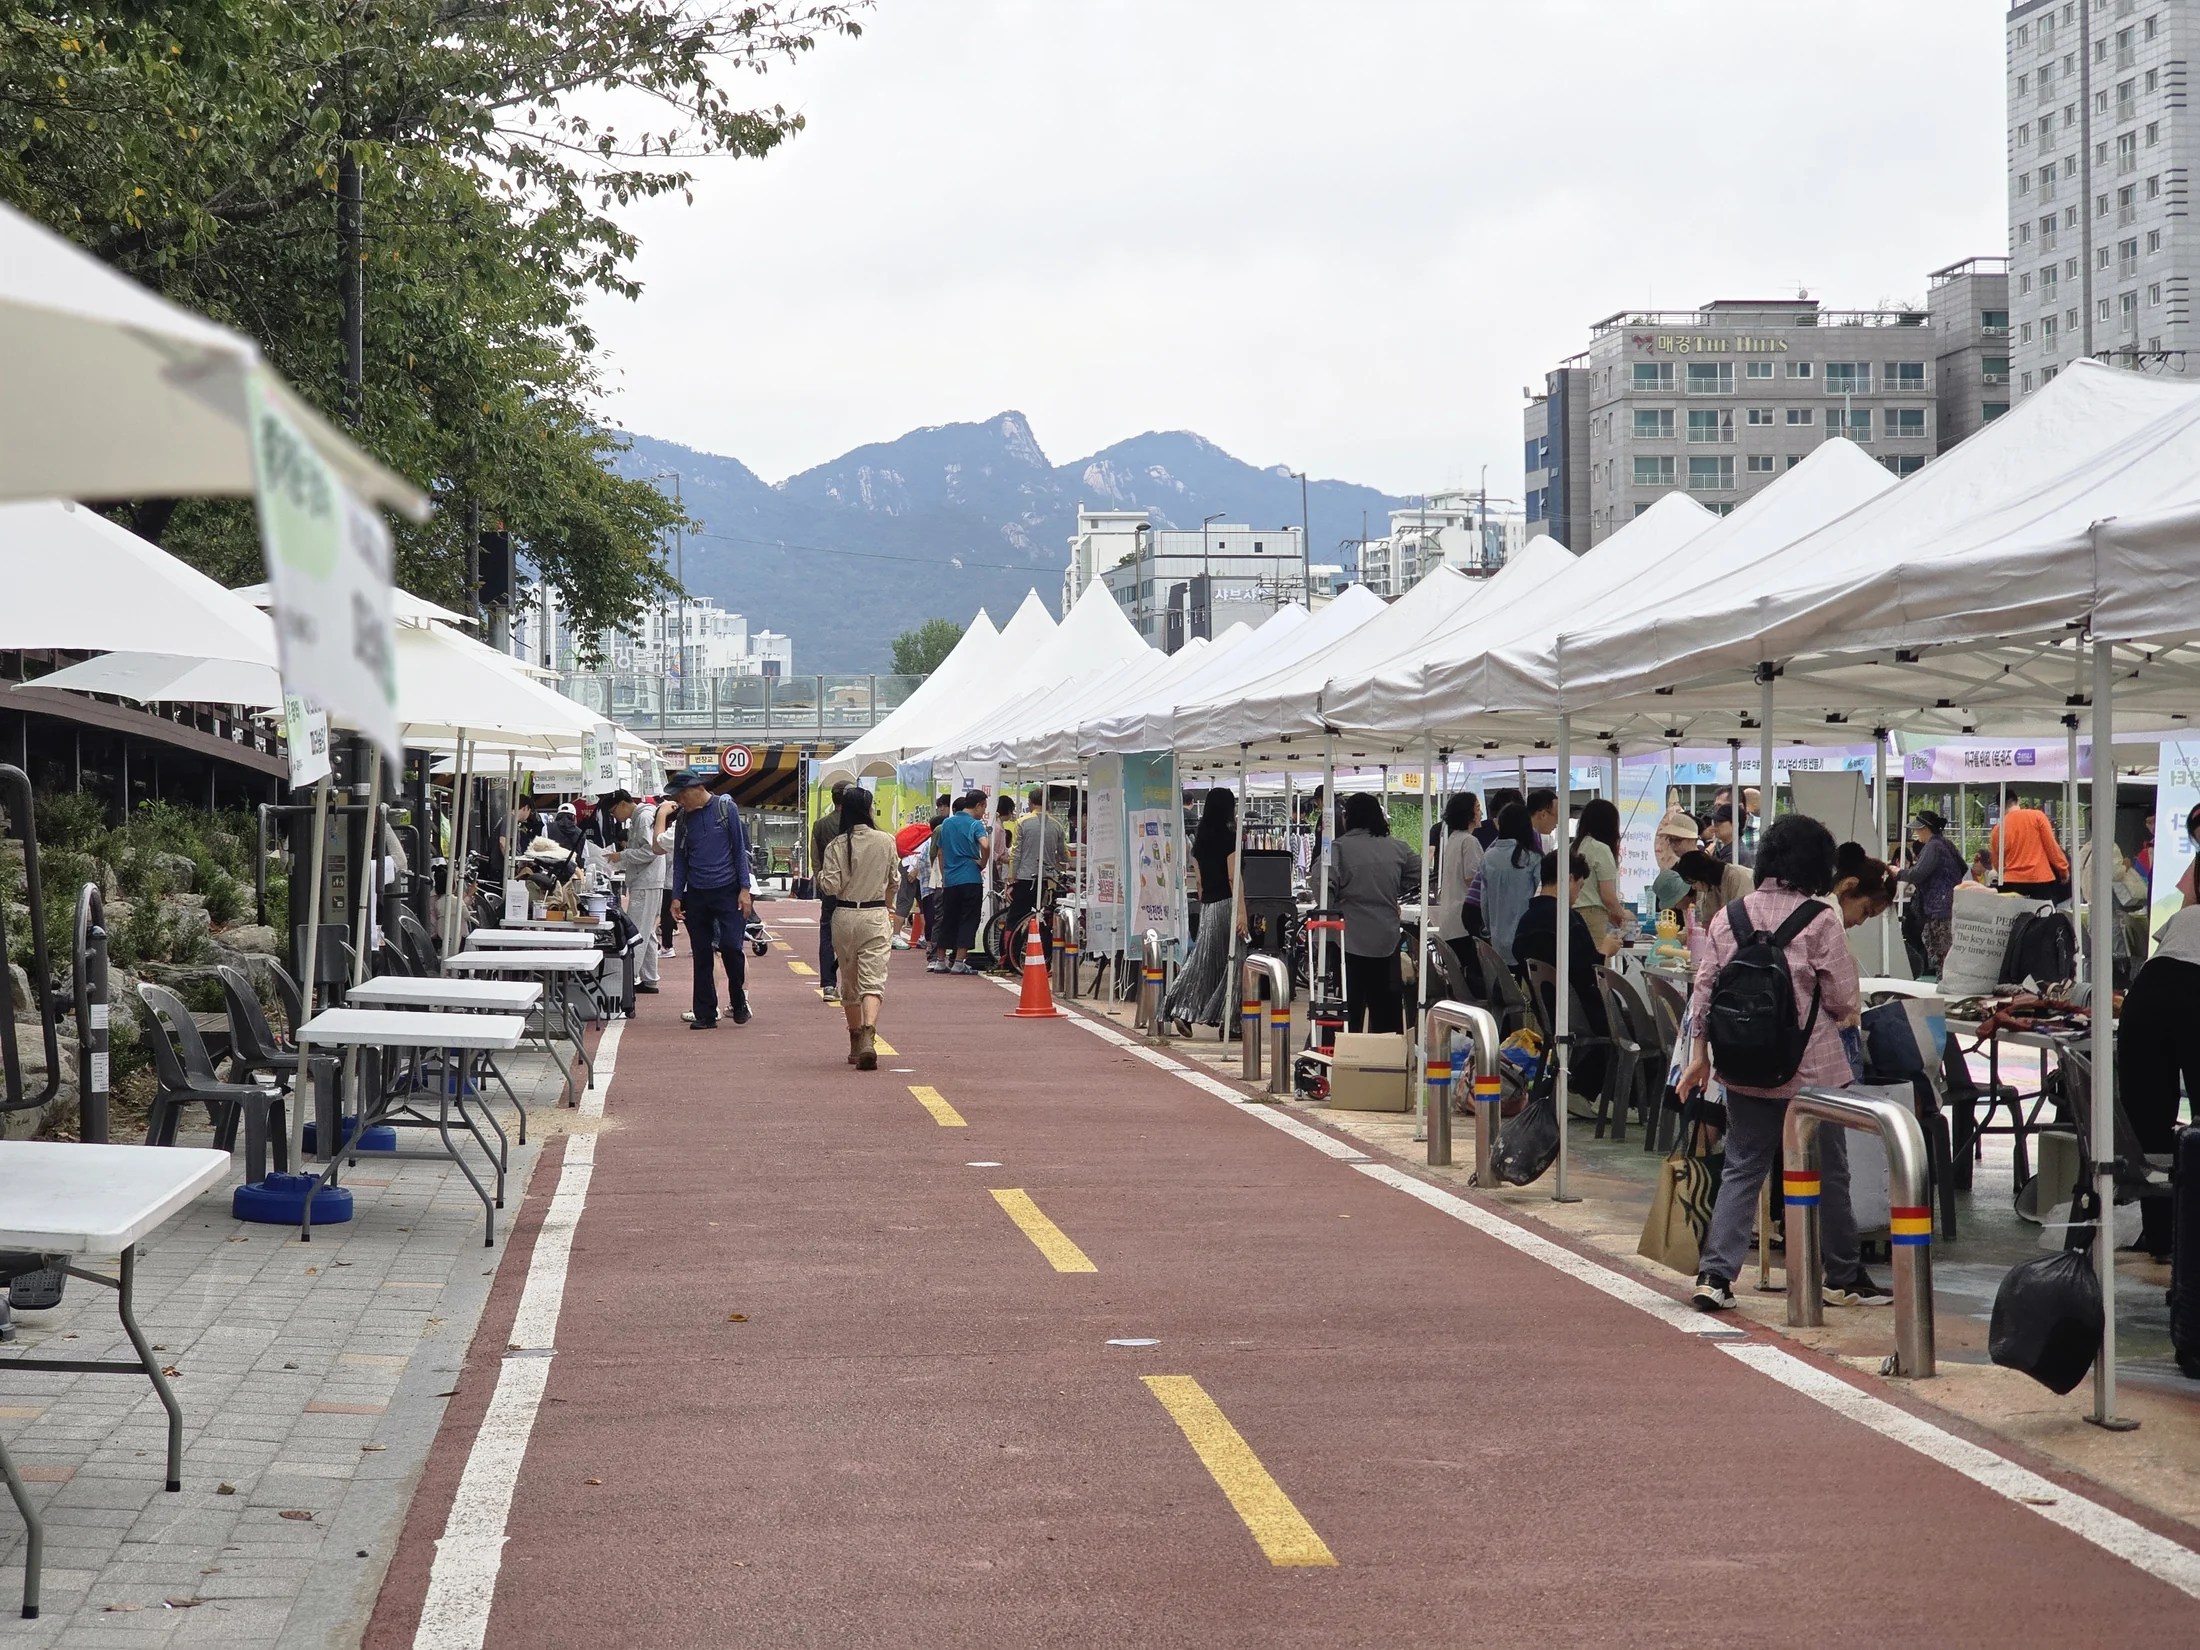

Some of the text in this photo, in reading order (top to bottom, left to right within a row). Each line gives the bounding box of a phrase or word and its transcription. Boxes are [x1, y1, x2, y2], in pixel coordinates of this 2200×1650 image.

[1658, 335, 1690, 354] 매경
[728, 752, 745, 767] 20
[1957, 932, 1969, 941] The
[1971, 934, 1985, 945] key
[1987, 938, 1995, 946] to
[1968, 946, 1986, 955] time
